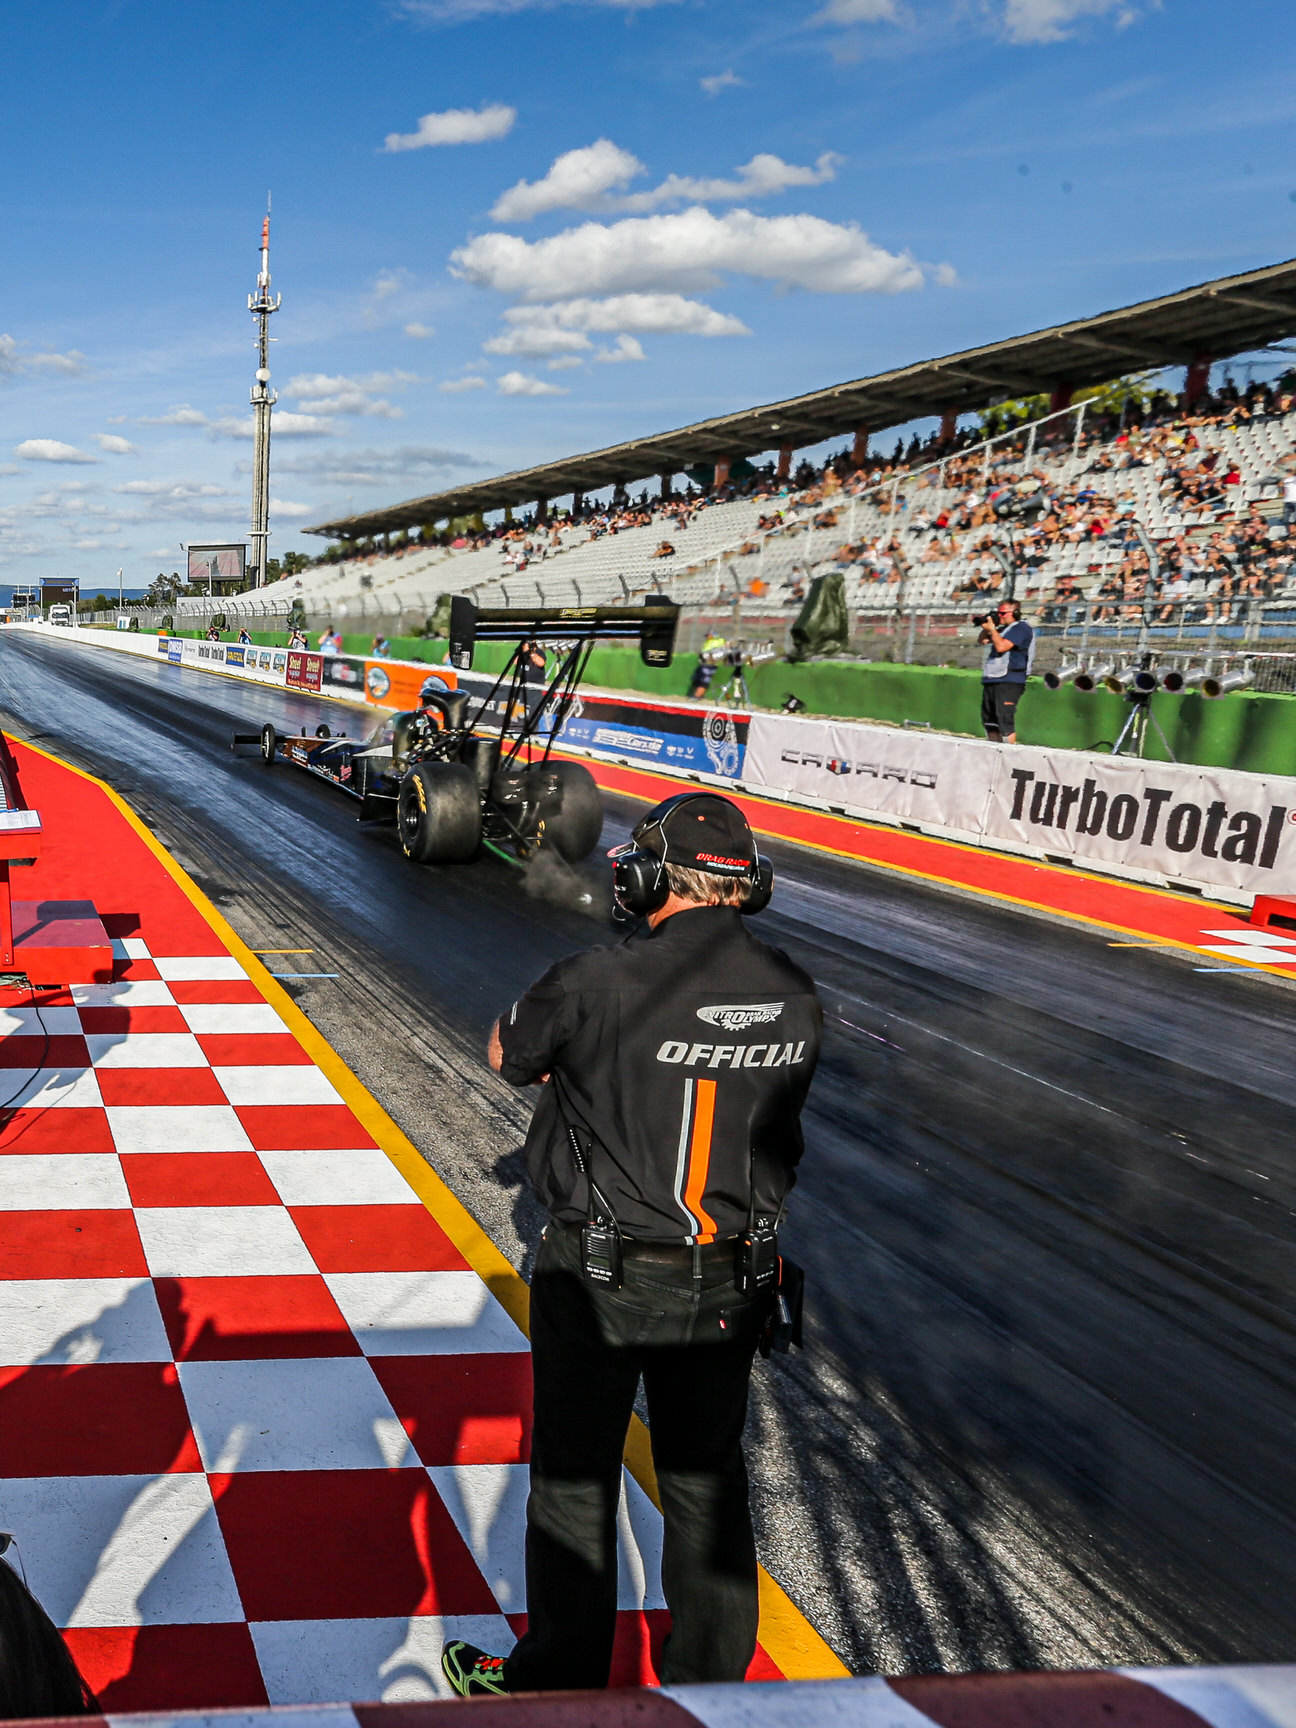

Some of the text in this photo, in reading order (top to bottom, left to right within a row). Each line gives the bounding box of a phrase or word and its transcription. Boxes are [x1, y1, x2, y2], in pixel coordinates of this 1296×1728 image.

[781, 749, 938, 789] CAMARO
[1009, 768, 1288, 870] TurboTotal
[696, 852, 726, 865] DRAG
[656, 1040, 806, 1069] OFFICIAL
